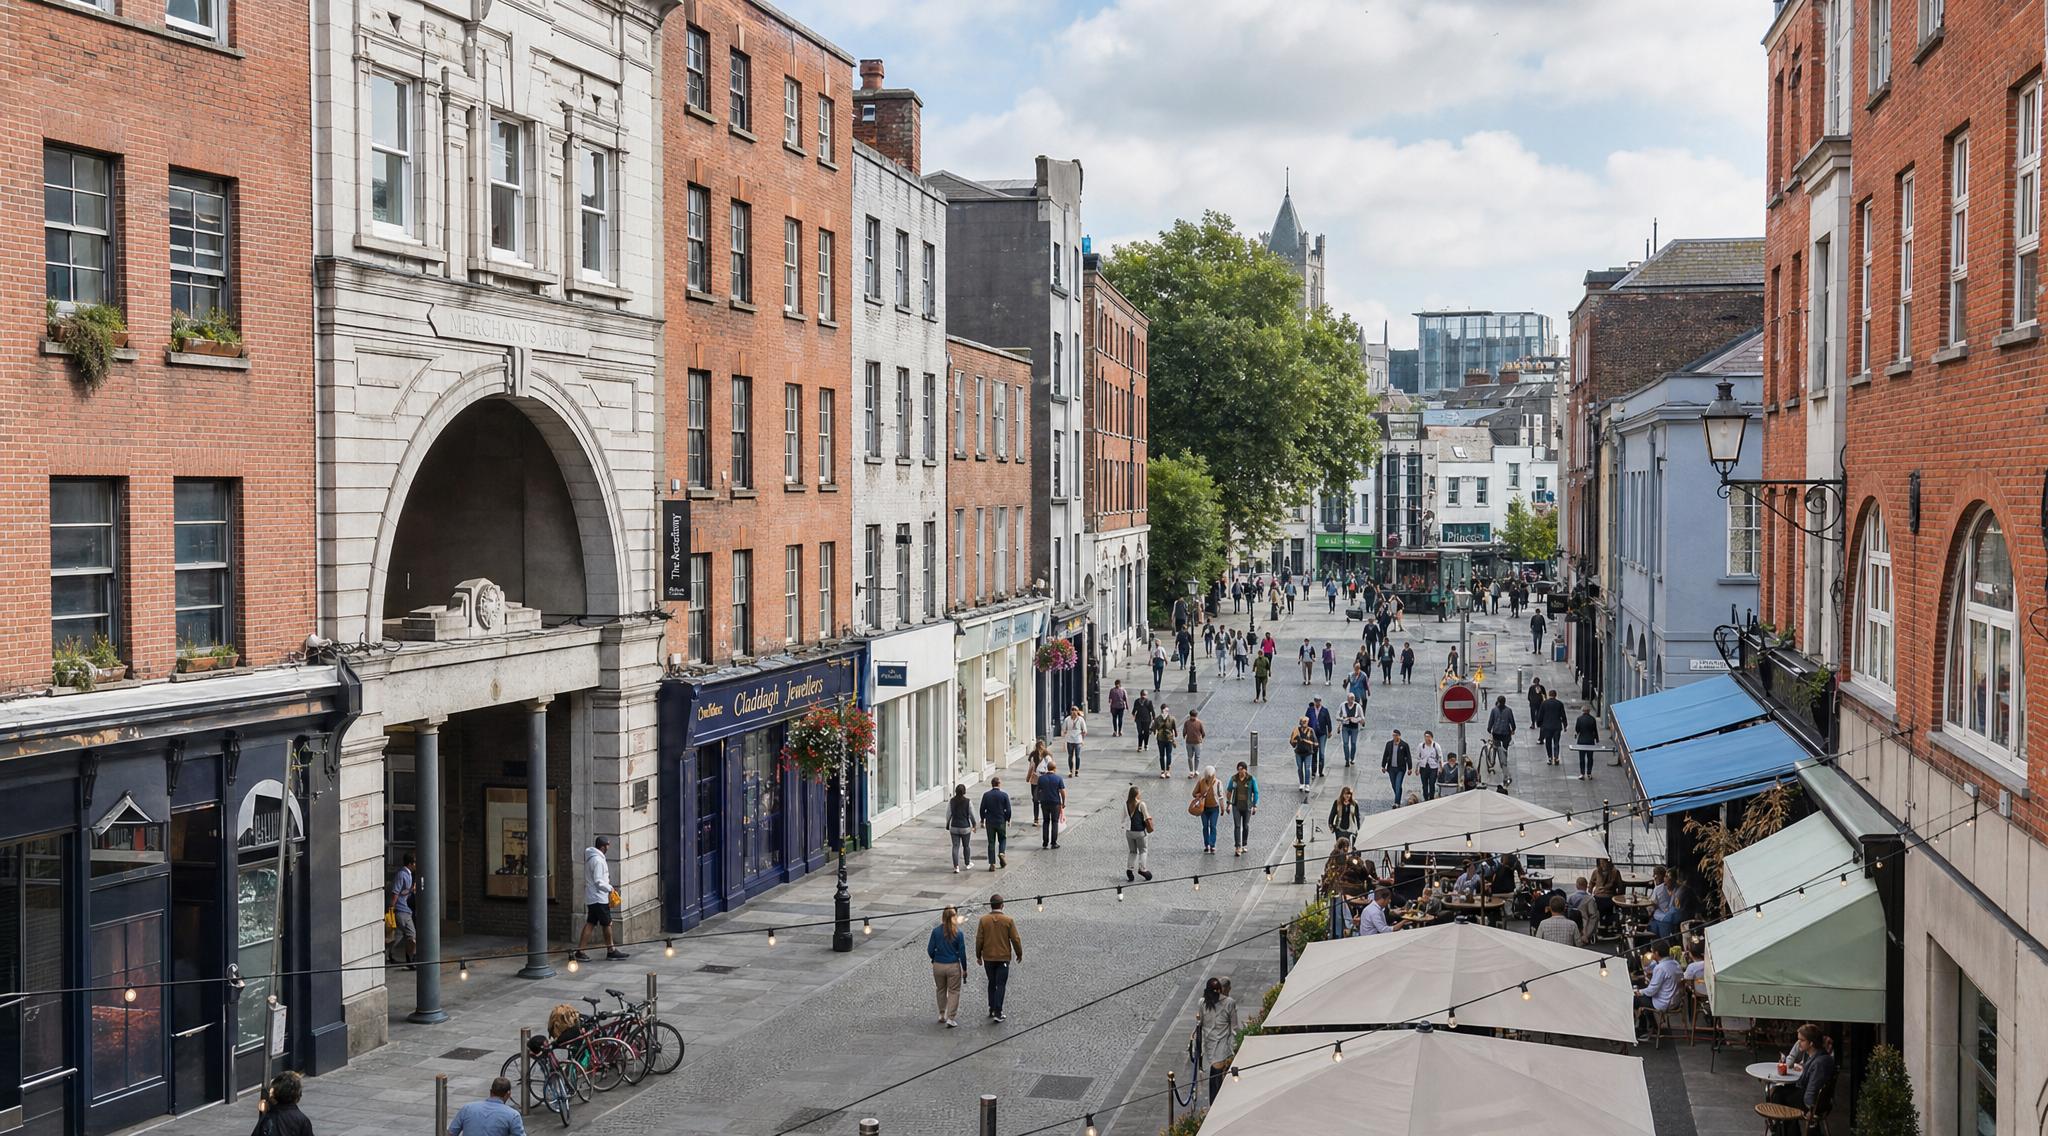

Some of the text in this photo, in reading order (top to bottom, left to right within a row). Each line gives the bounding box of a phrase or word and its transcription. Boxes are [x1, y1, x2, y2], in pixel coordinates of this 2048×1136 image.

[450, 312, 580, 350] MERCHANTS ARCH
[671, 561, 680, 579] The
[734, 683, 779, 717] Claddagh
[784, 675, 824, 708] Jewellers
[1741, 993, 1802, 1007] LADURÉE
